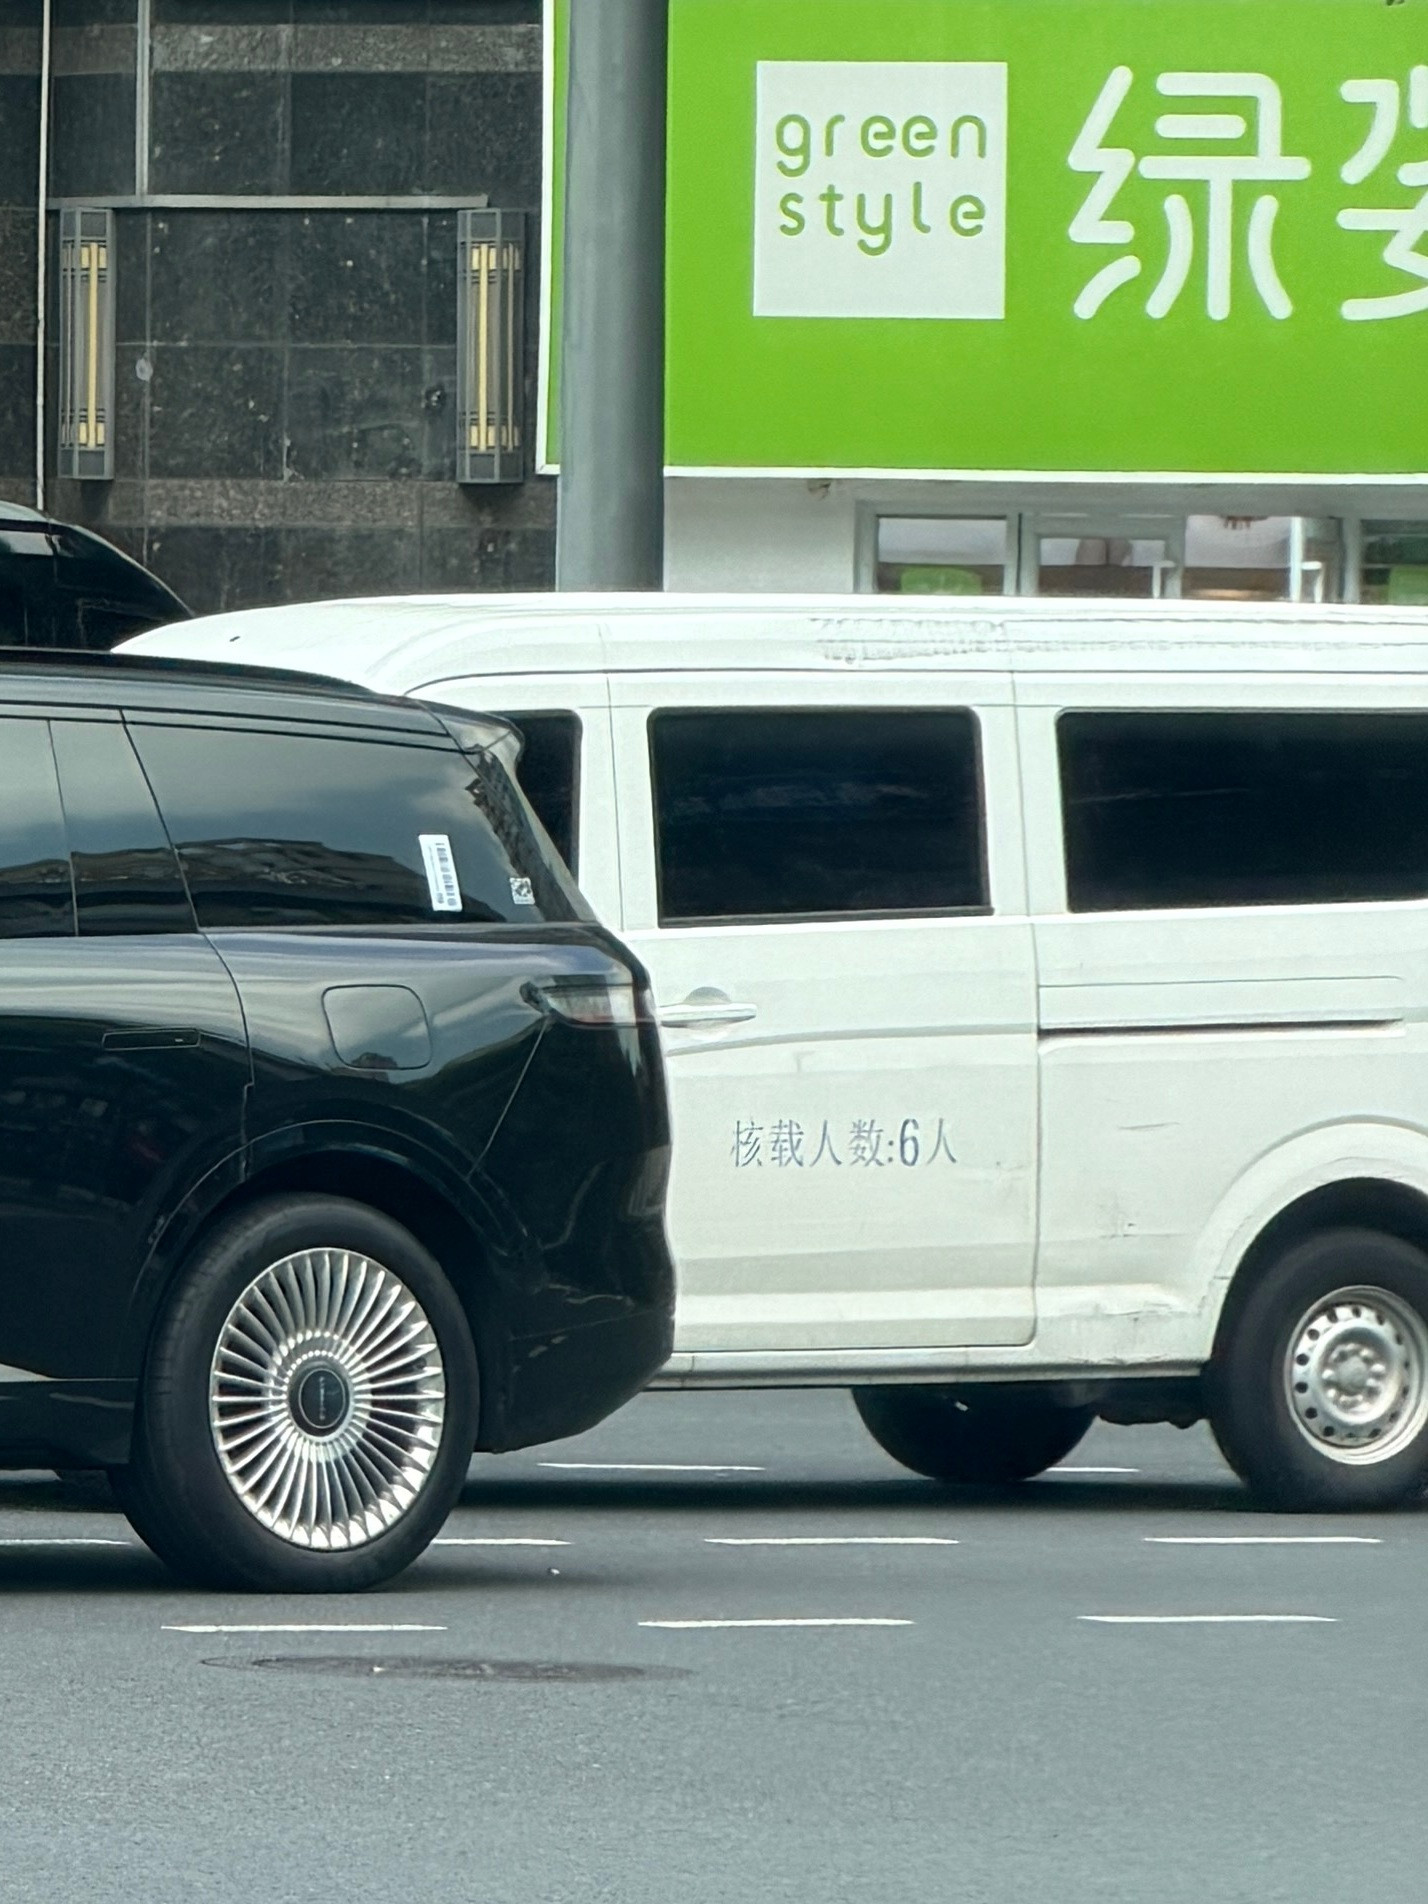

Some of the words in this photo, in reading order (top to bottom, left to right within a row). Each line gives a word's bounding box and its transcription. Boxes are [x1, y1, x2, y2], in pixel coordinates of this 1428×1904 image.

[775, 112, 988, 178] green
[777, 182, 987, 257] style
[729, 1117, 958, 1168] 核载人数:6人
